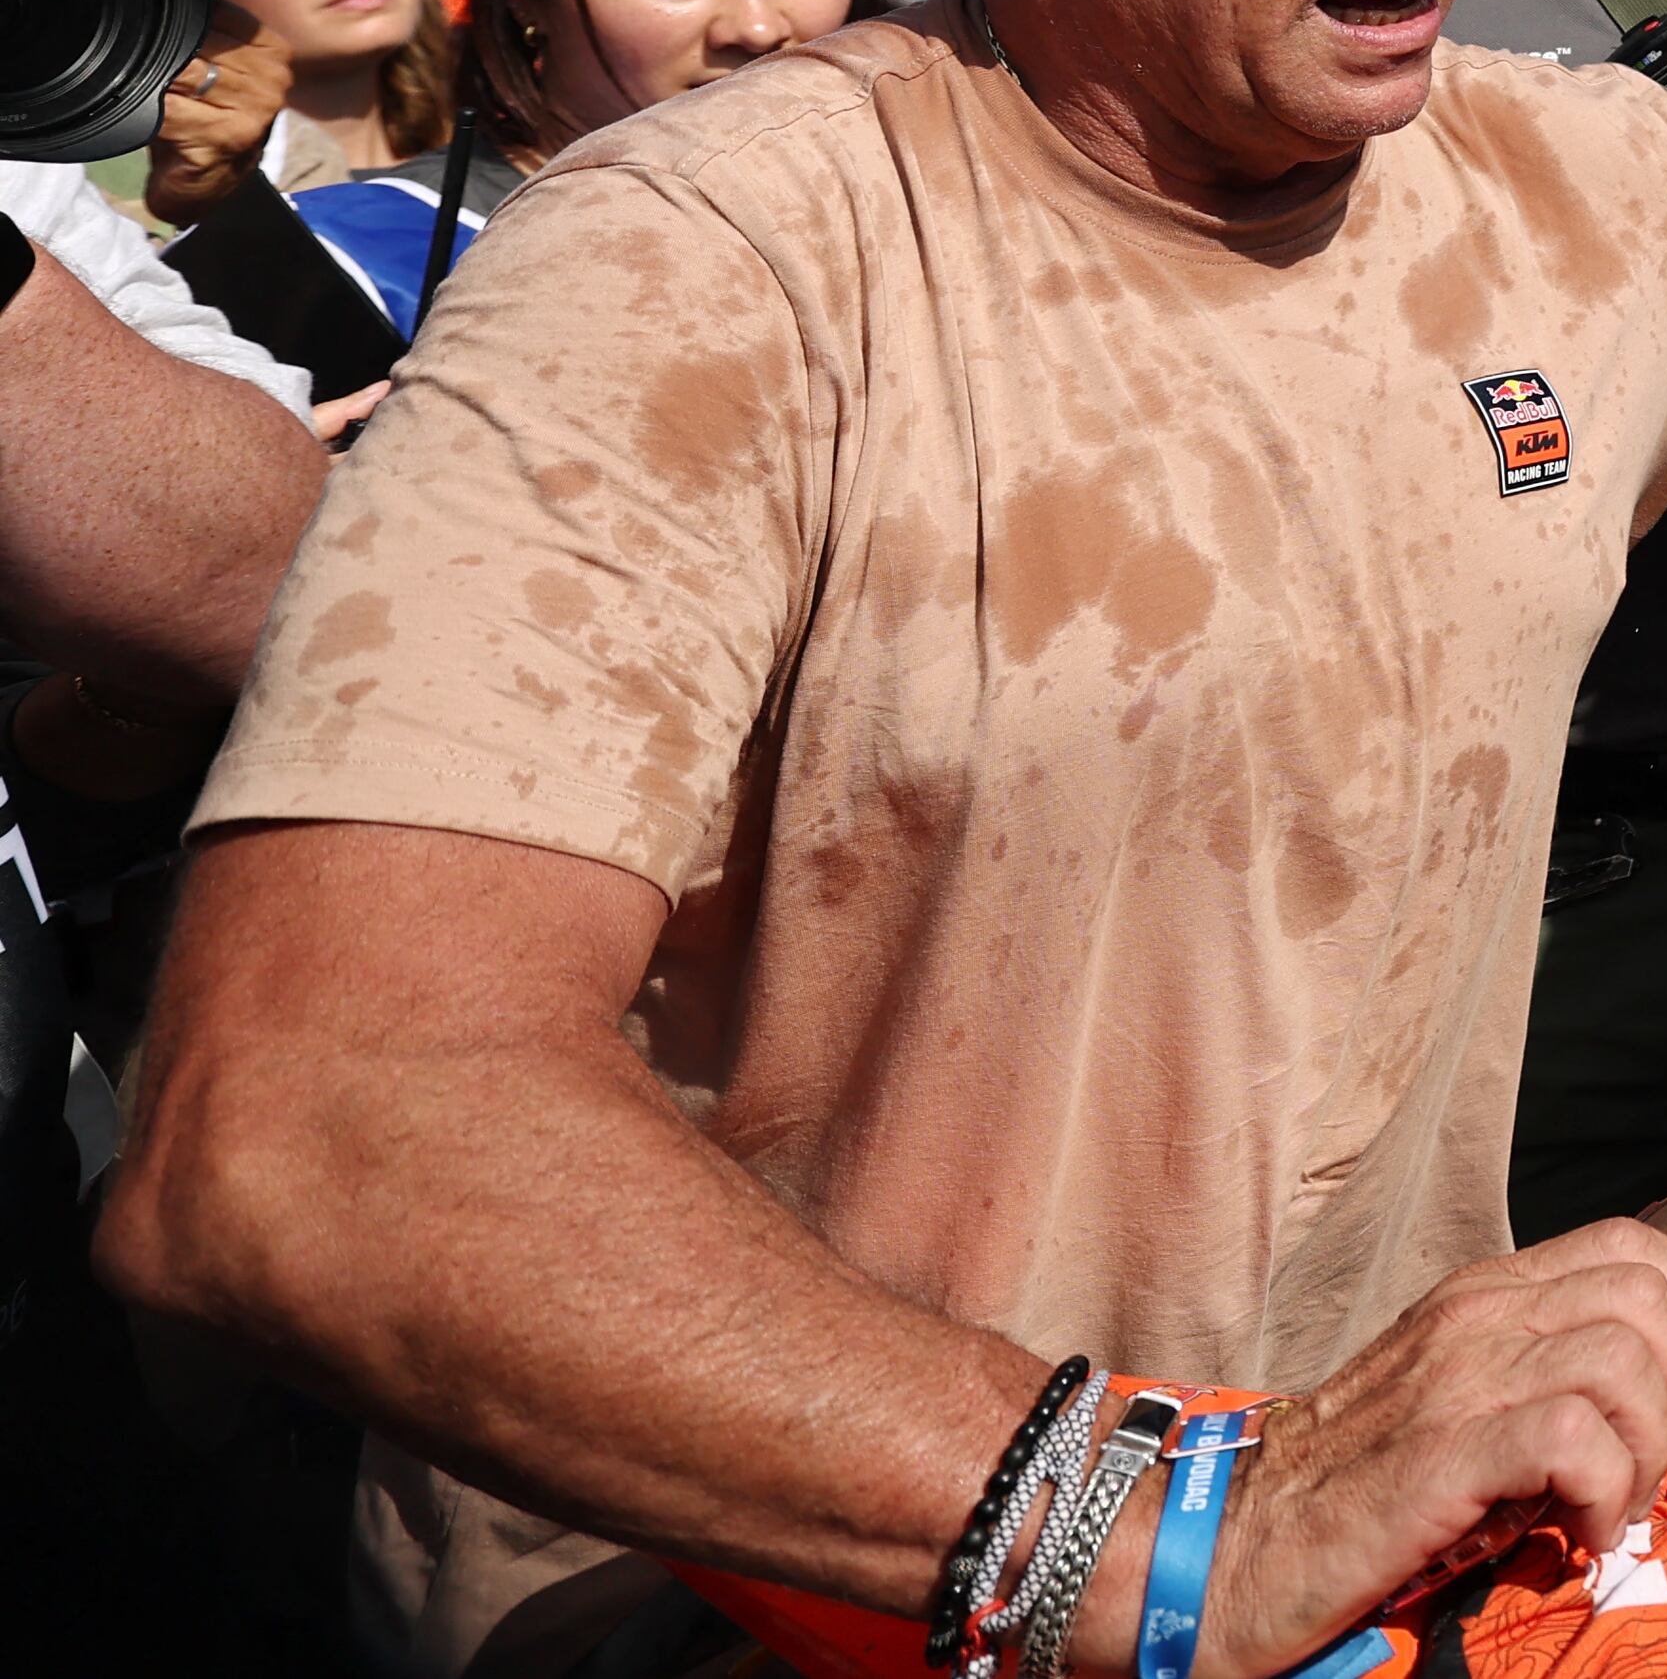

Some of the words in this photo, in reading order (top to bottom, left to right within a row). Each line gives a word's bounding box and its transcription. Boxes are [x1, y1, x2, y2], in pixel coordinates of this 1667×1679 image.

[1515, 430, 1559, 457] KTM
[1507, 465, 1542, 485] RACING
[1544, 459, 1567, 476] TEAM
[1180, 1429, 1219, 1513] BVOUAC
